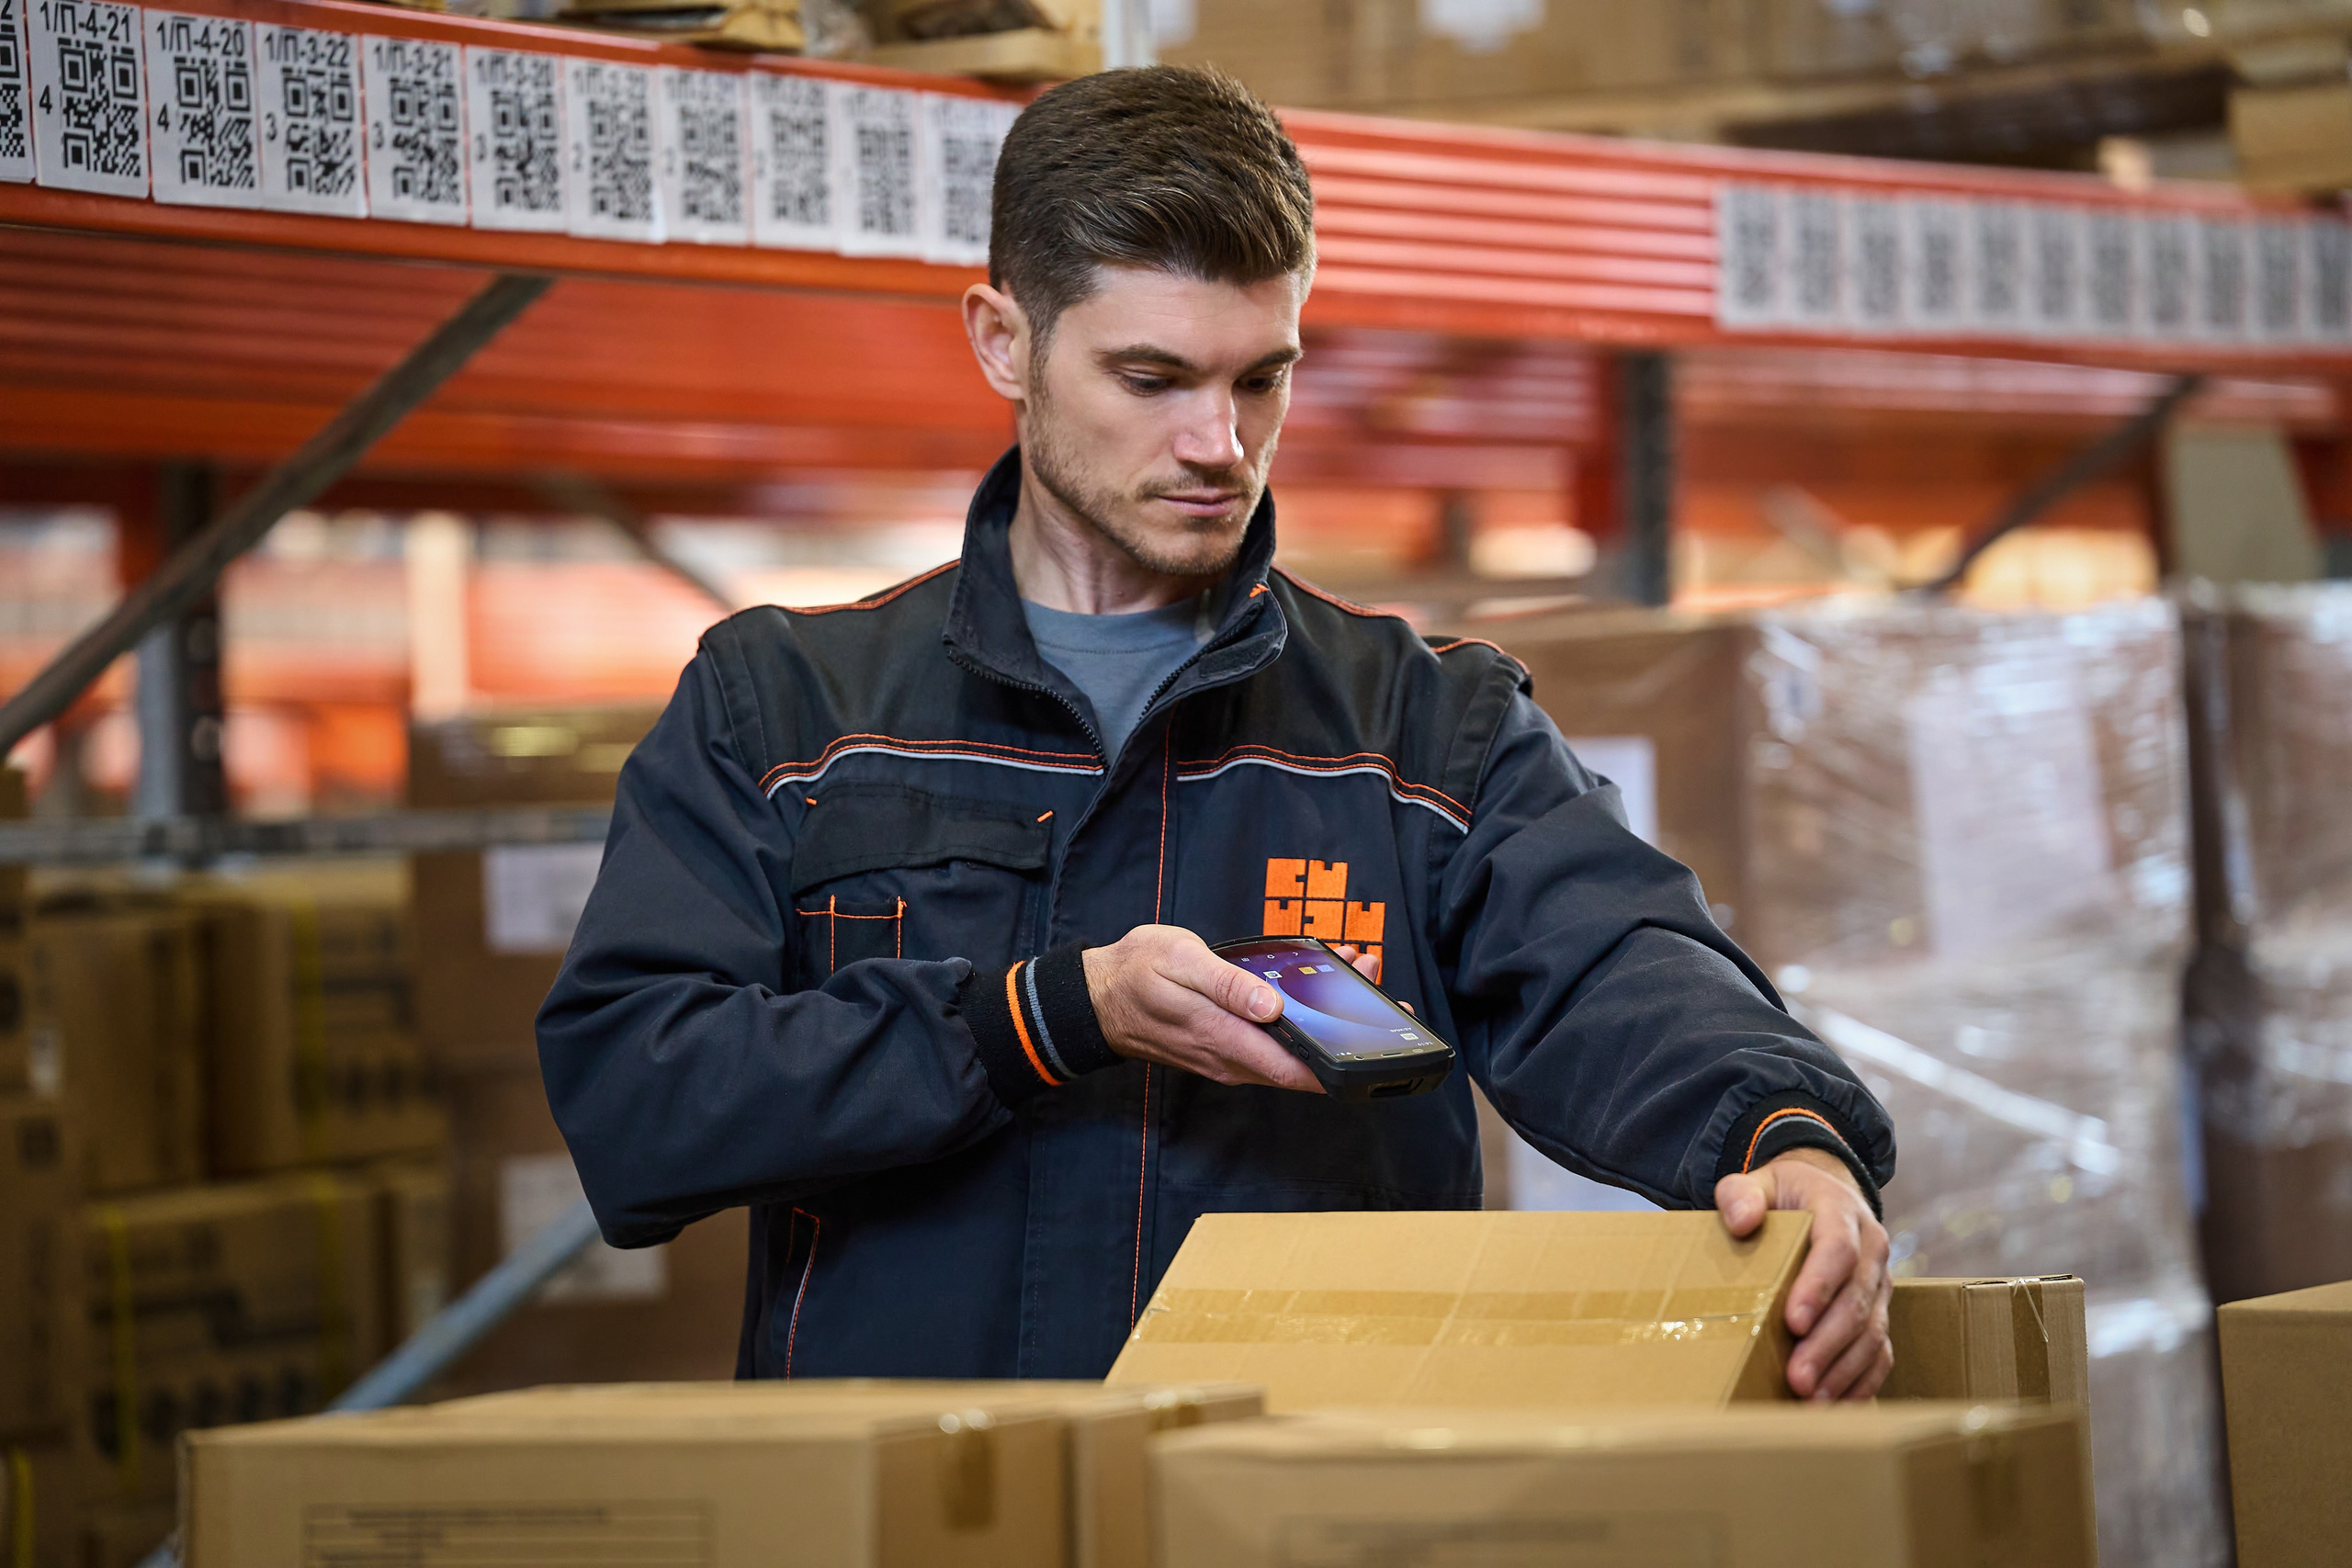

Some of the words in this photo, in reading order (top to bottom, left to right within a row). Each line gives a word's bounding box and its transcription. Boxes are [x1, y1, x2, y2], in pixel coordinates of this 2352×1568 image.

[40, 0, 130, 43] 1/П-4-21
[157, 19, 245, 57] 1/П-4-20
[265, 32, 350, 68] 1/П-3-22
[39, 85, 52, 115] 4
[157, 102, 170, 132] 4
[265, 110, 277, 141] 3
[372, 119, 385, 149] 3
